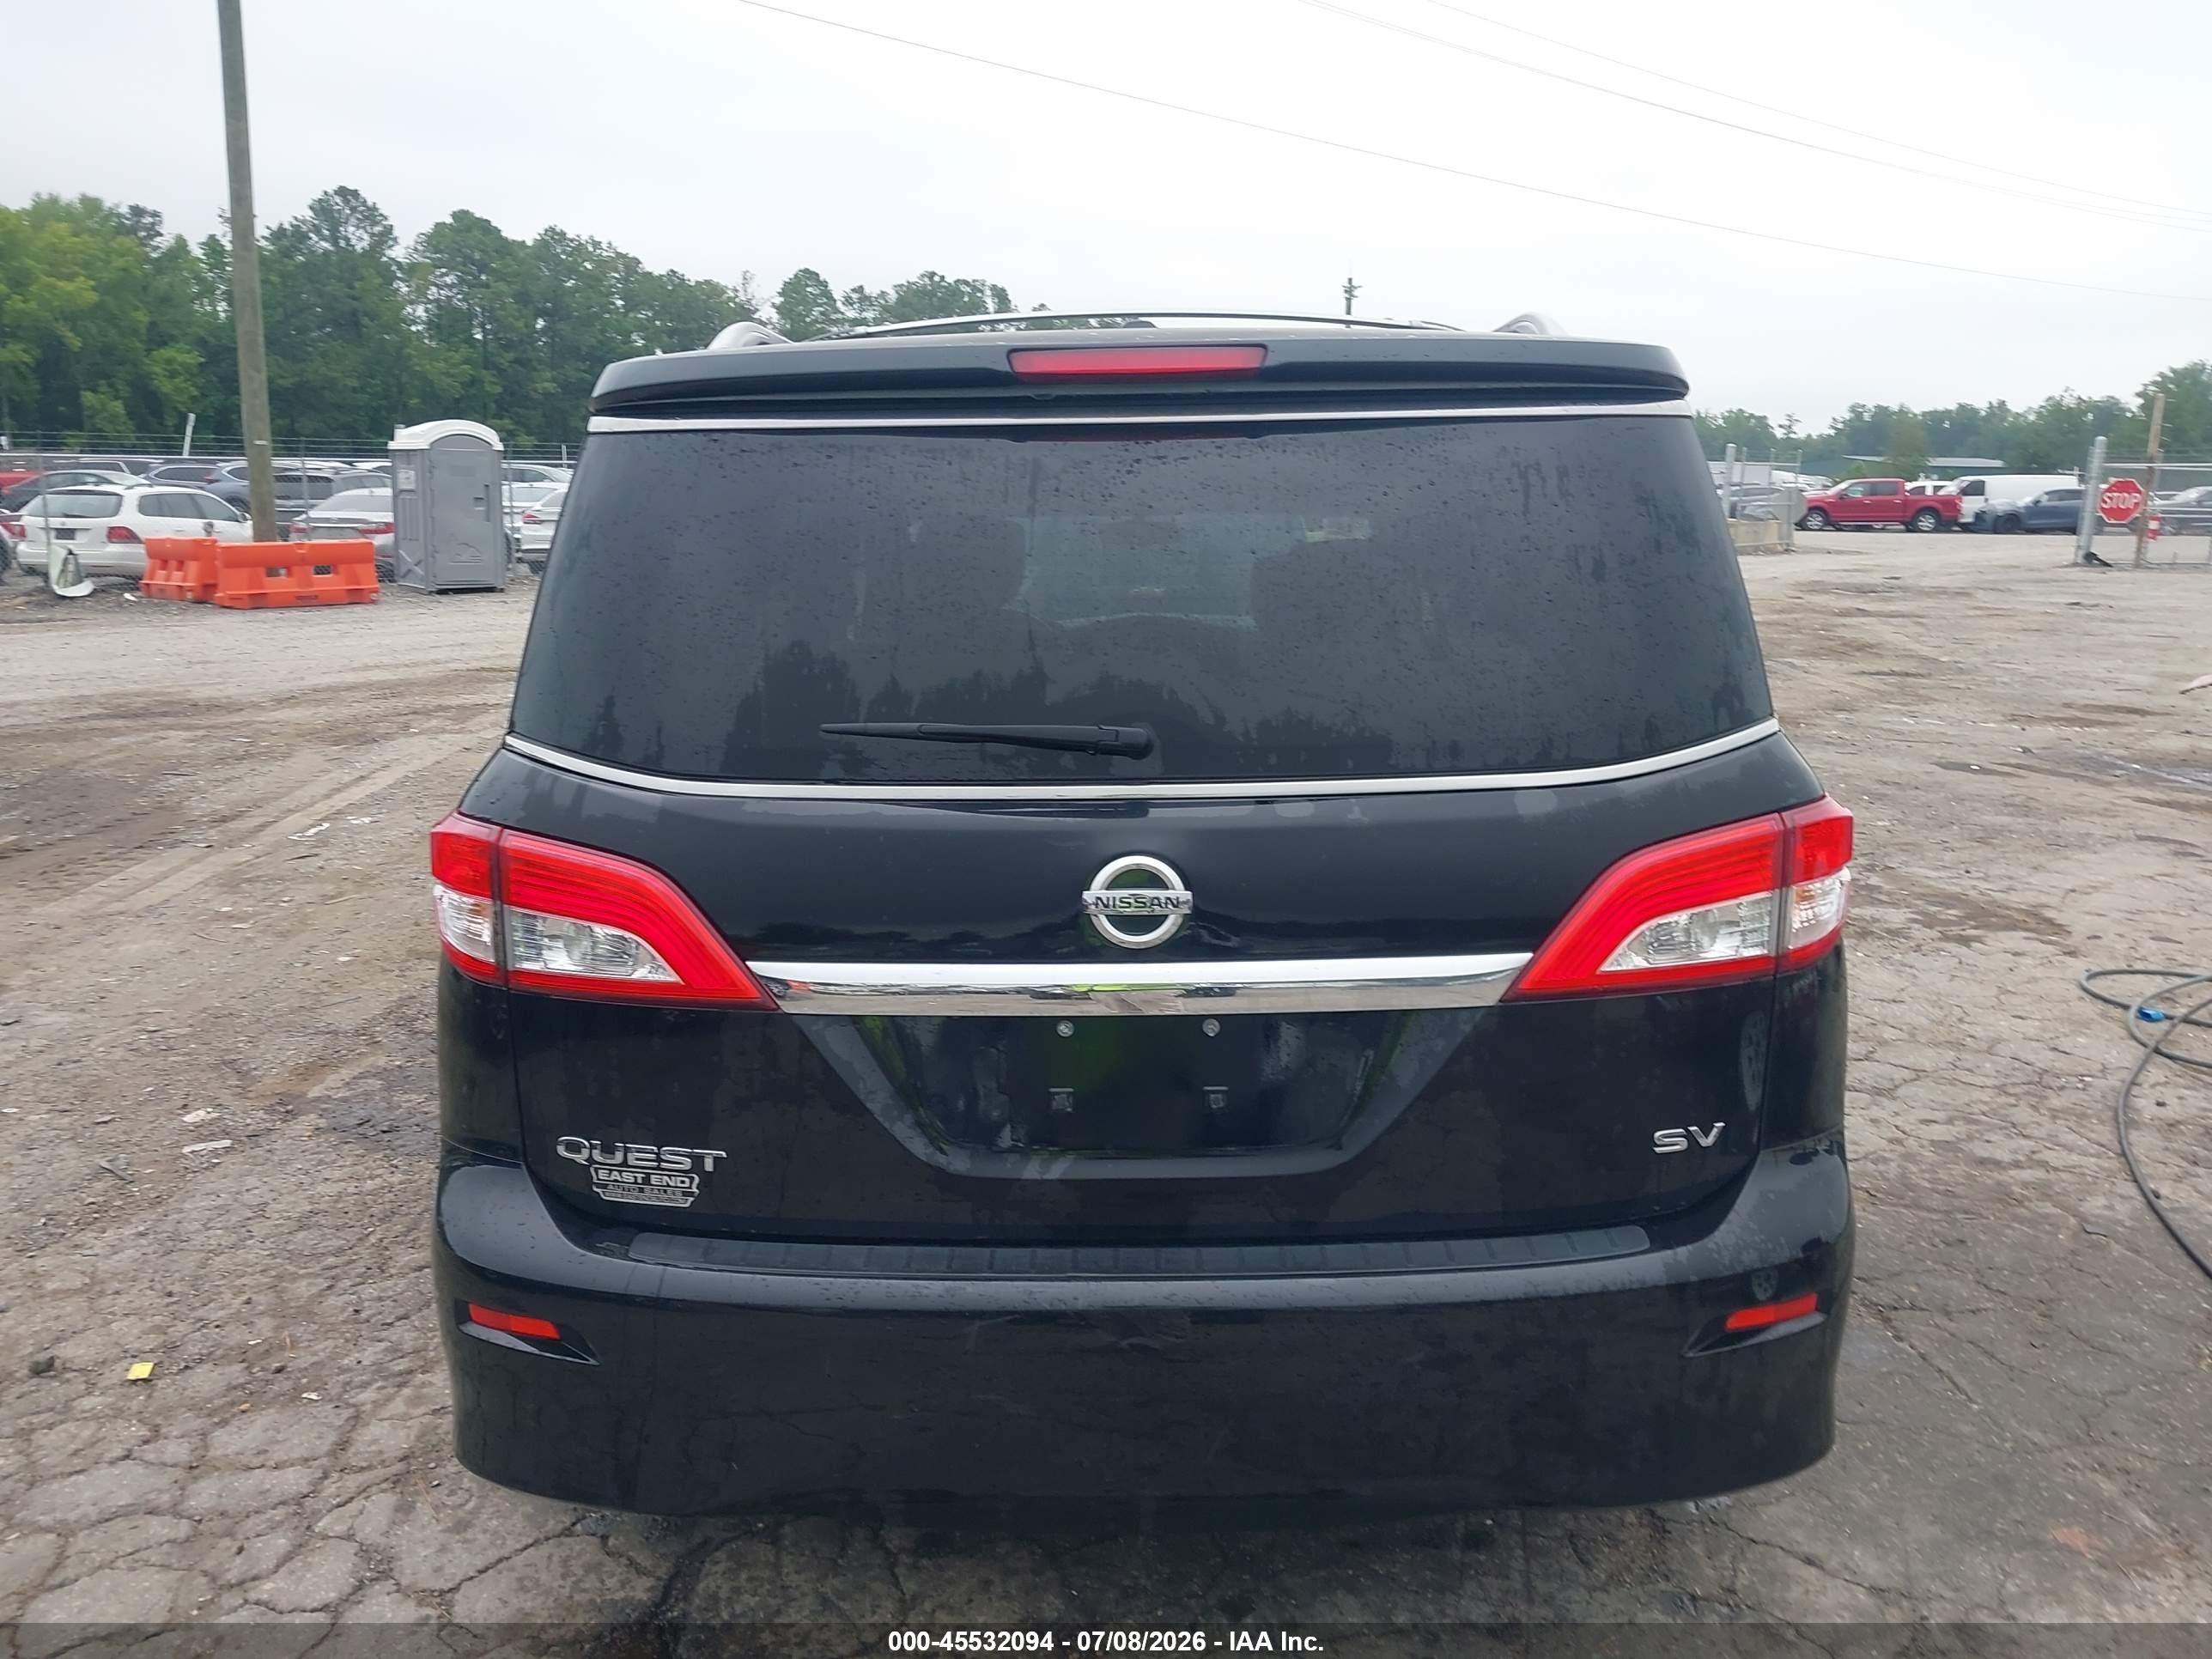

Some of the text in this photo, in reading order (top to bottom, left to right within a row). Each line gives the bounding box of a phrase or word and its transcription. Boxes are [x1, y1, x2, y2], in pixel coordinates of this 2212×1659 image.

[2100, 492, 2142, 508] STOP
[1095, 896, 1180, 909] NISSAN
[1652, 1121, 1726, 1154] SV
[556, 1136, 727, 1172] QUEST
[598, 1169, 690, 1188] EAST END
[606, 1183, 683, 1197] AUTO SALES
